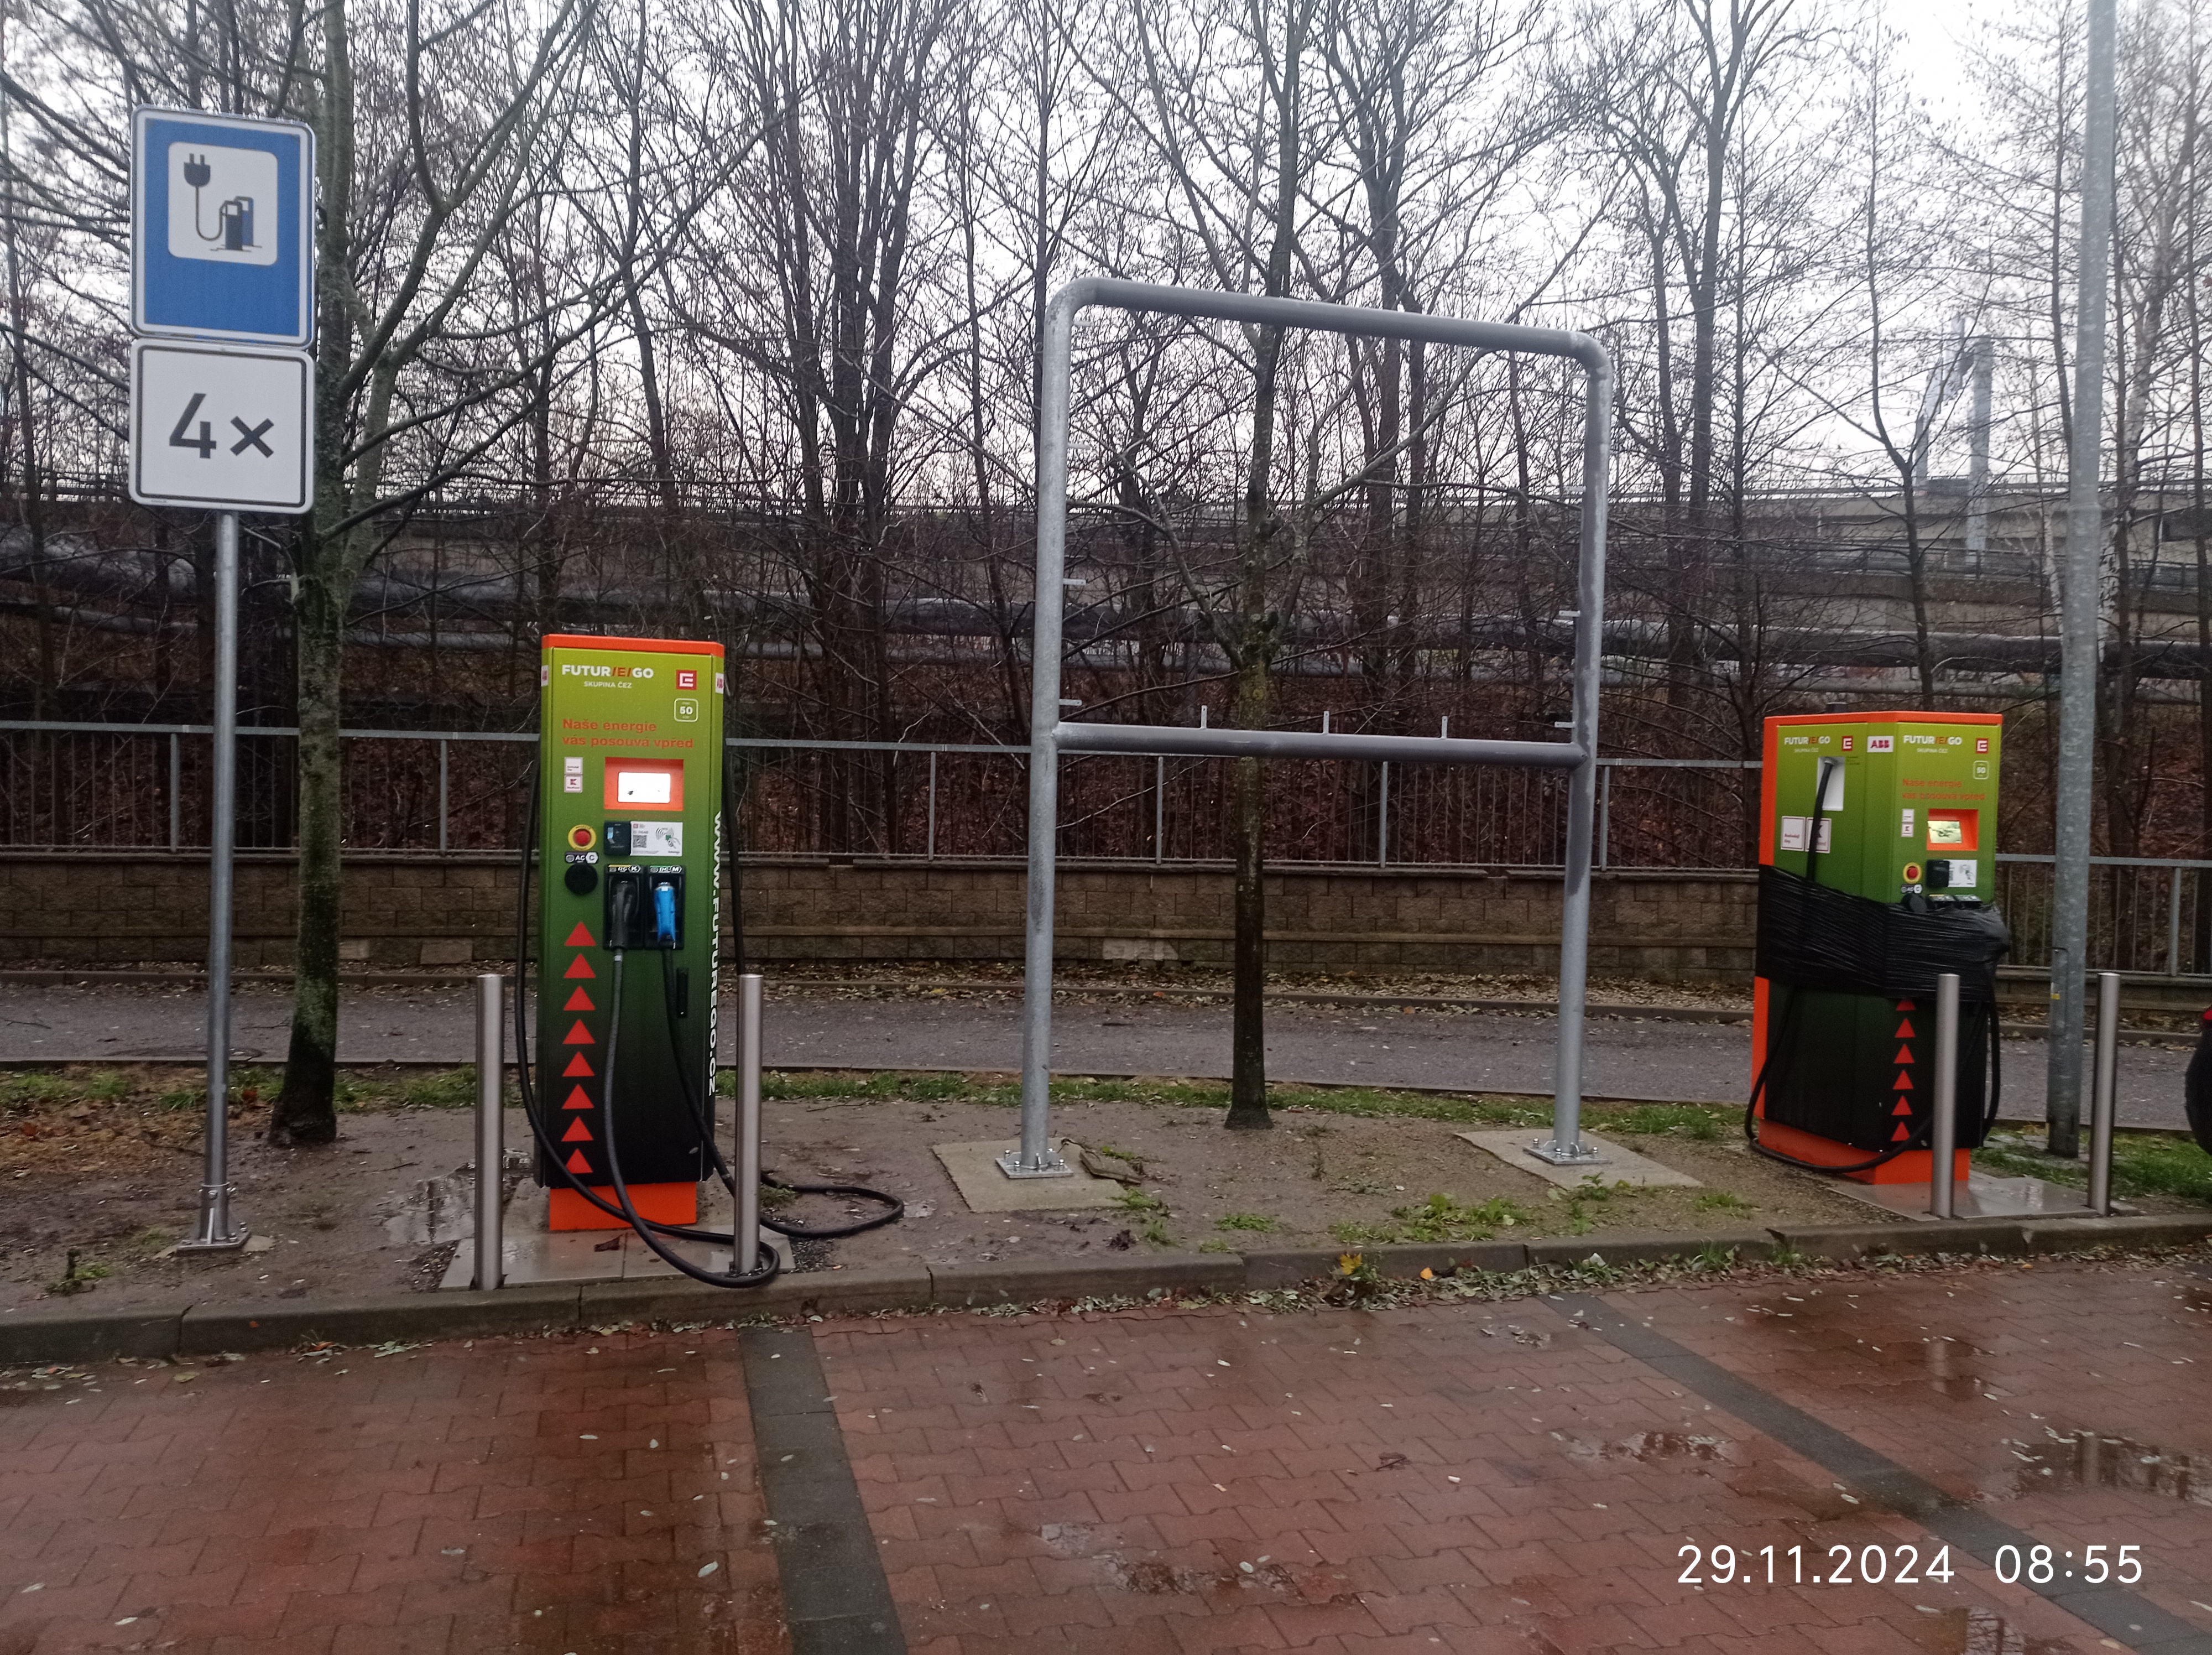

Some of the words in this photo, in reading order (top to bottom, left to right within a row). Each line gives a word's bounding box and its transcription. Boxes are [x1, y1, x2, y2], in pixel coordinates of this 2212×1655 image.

[680, 706, 693, 715] 50
[562, 719, 598, 730] Naše
[603, 721, 657, 733] energie
[562, 735, 586, 746] vás
[591, 736, 650, 747] posouvá
[654, 737, 694, 749] vpřed
[1870, 740, 1890, 748] ABB
